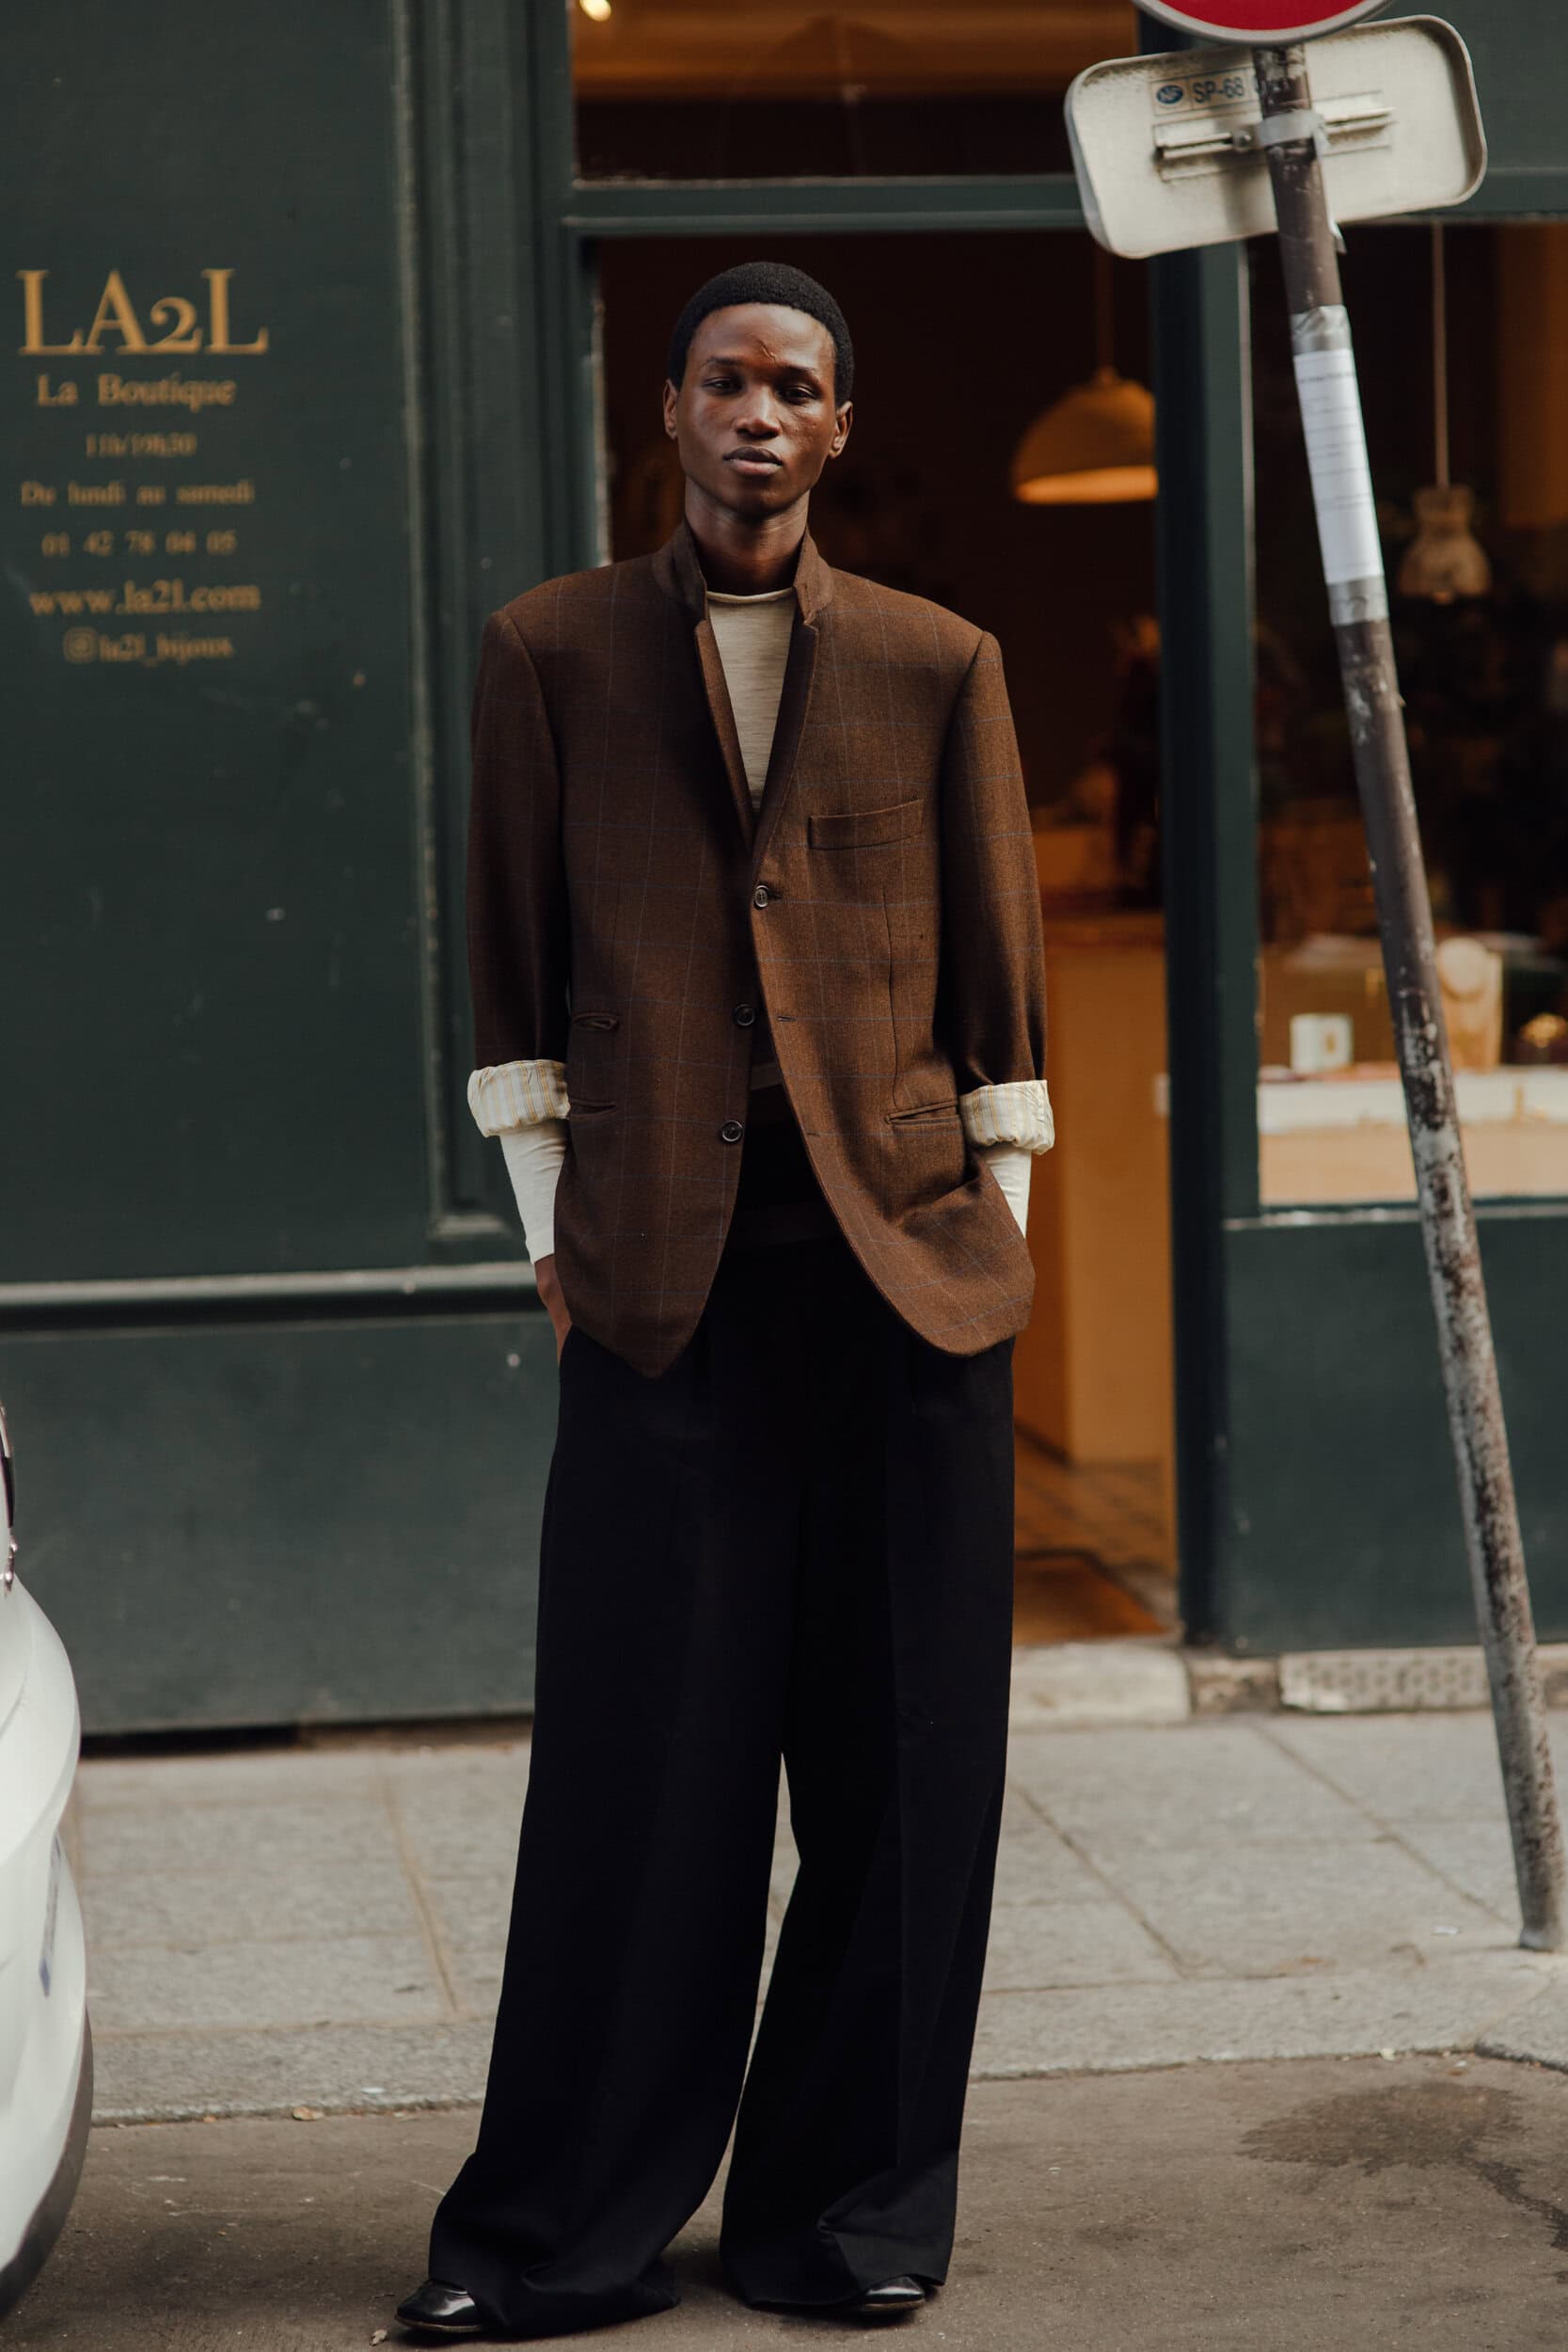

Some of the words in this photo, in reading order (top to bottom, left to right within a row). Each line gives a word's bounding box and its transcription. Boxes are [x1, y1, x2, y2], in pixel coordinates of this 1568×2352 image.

[15, 268, 269, 355] LA2L
[37, 374, 78, 406] La
[98, 373, 235, 413] Boutique
[41, 532, 70, 557] 01
[29, 578, 261, 615] www.la2l.com
